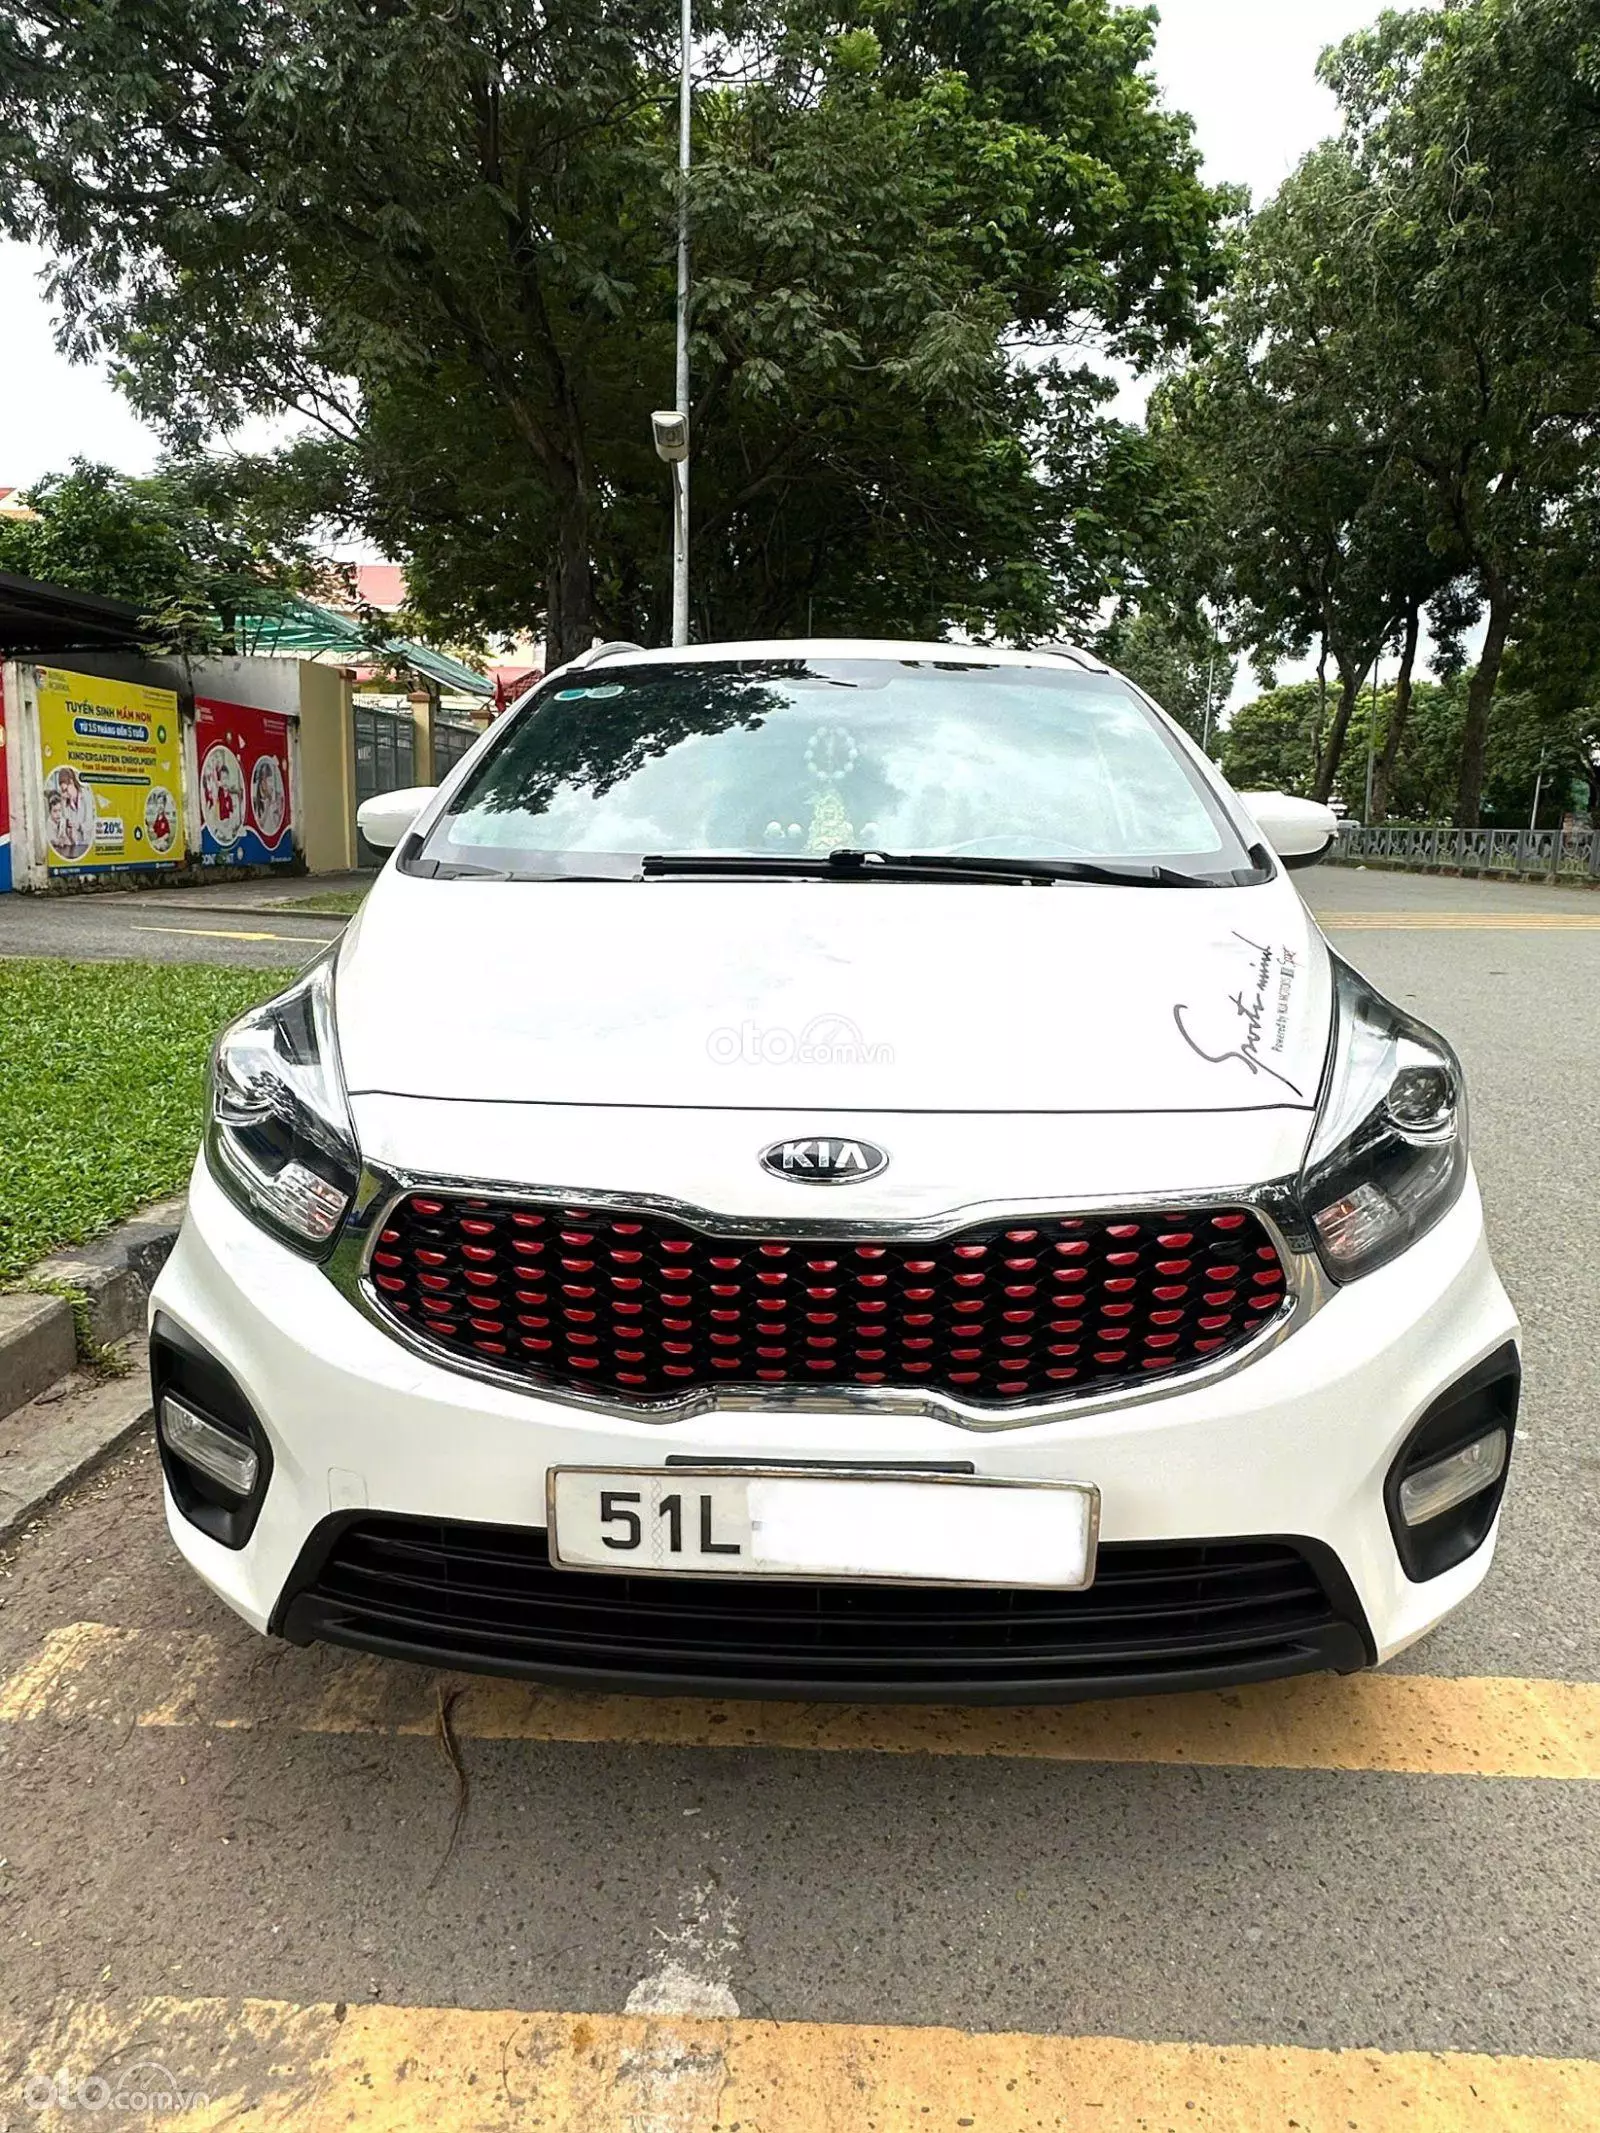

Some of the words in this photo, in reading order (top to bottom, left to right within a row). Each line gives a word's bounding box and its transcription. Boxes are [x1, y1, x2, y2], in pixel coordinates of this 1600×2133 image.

[65, 699, 94, 715] TUYỂN
[96, 705, 115, 717] SINH
[136, 711, 152, 722] NON
[89, 722, 97, 733] 15
[68, 752, 120, 763] KINDERGARTEN
[103, 821, 123, 834] 20%
[782, 1141, 869, 1169] KIA
[600, 1490, 741, 1555] 51L
